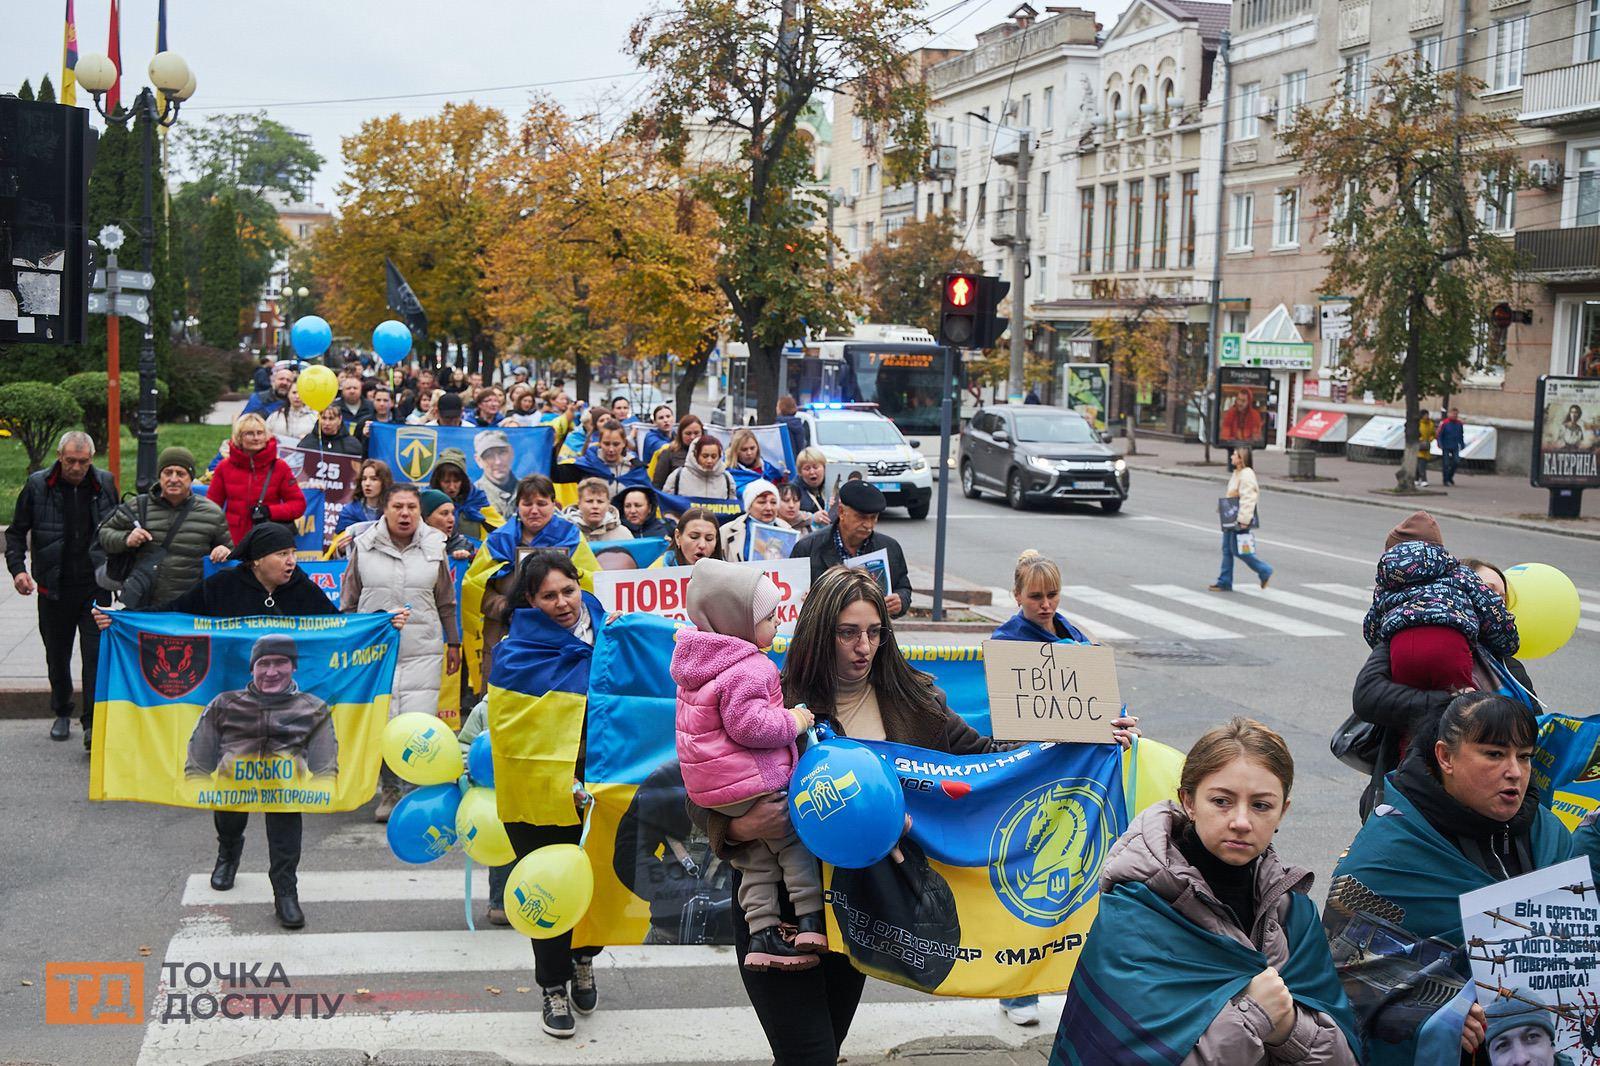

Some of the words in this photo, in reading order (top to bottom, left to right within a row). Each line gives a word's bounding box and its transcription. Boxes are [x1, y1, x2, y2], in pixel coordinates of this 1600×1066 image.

[316, 461, 340, 480] 25
[1543, 453, 1597, 476] КАТЕРИНА
[194, 617, 213, 631] МИ
[215, 617, 242, 631] ТЕБЕ
[245, 616, 296, 630] ЧЕКАЄМО
[298, 616, 348, 630] ДОДОМУ
[329, 651, 348, 669] 41
[1040, 642, 1055, 669] Я
[1011, 667, 1078, 692] ТВІЙ
[1016, 694, 1102, 720] ГОЛОС
[235, 759, 292, 781] БОСЬКО
[801, 763, 831, 786] Україна!
[198, 787, 259, 806] АНАТОЛІЙ
[260, 788, 331, 806] ВІКТОРОВИЧ
[1514, 898, 1542, 918] ВІН
[1546, 904, 1598, 922] БОРЕТЬСЯ
[1530, 921, 1546, 936] ЗА
[994, 930, 1091, 967] «МАГУР
[1501, 939, 1518, 954] ЗА
[1513, 954, 1570, 973] ПОВЕРНІТЬ
[1528, 971, 1590, 991] ЧОЛОВІКА!
